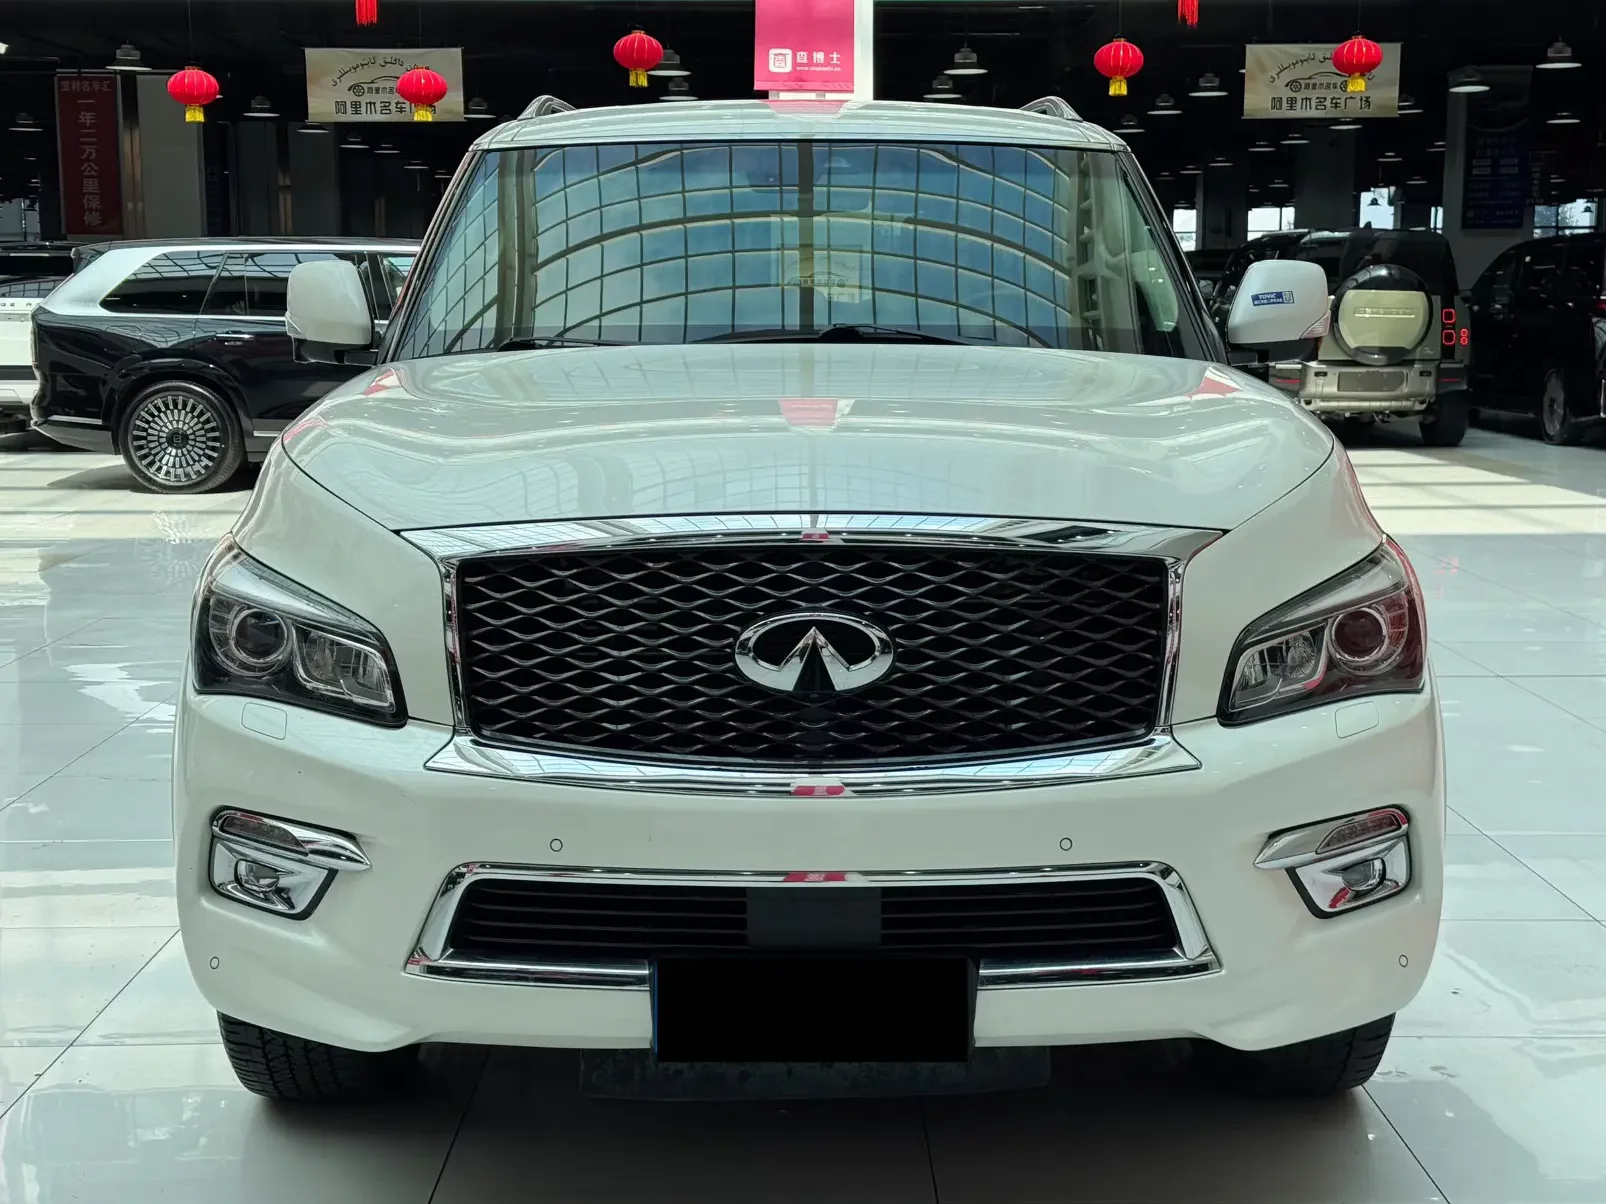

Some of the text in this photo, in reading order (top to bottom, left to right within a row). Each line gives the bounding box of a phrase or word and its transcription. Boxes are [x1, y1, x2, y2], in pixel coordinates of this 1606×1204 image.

[796, 51, 841, 64] 查博士
[366, 86, 397, 95] 阿里木名
[1303, 82, 1338, 91] 阿里木名车
[1270, 96, 1372, 111] 阿里木名车广场
[76, 99, 102, 227] 一年二万公里保修
